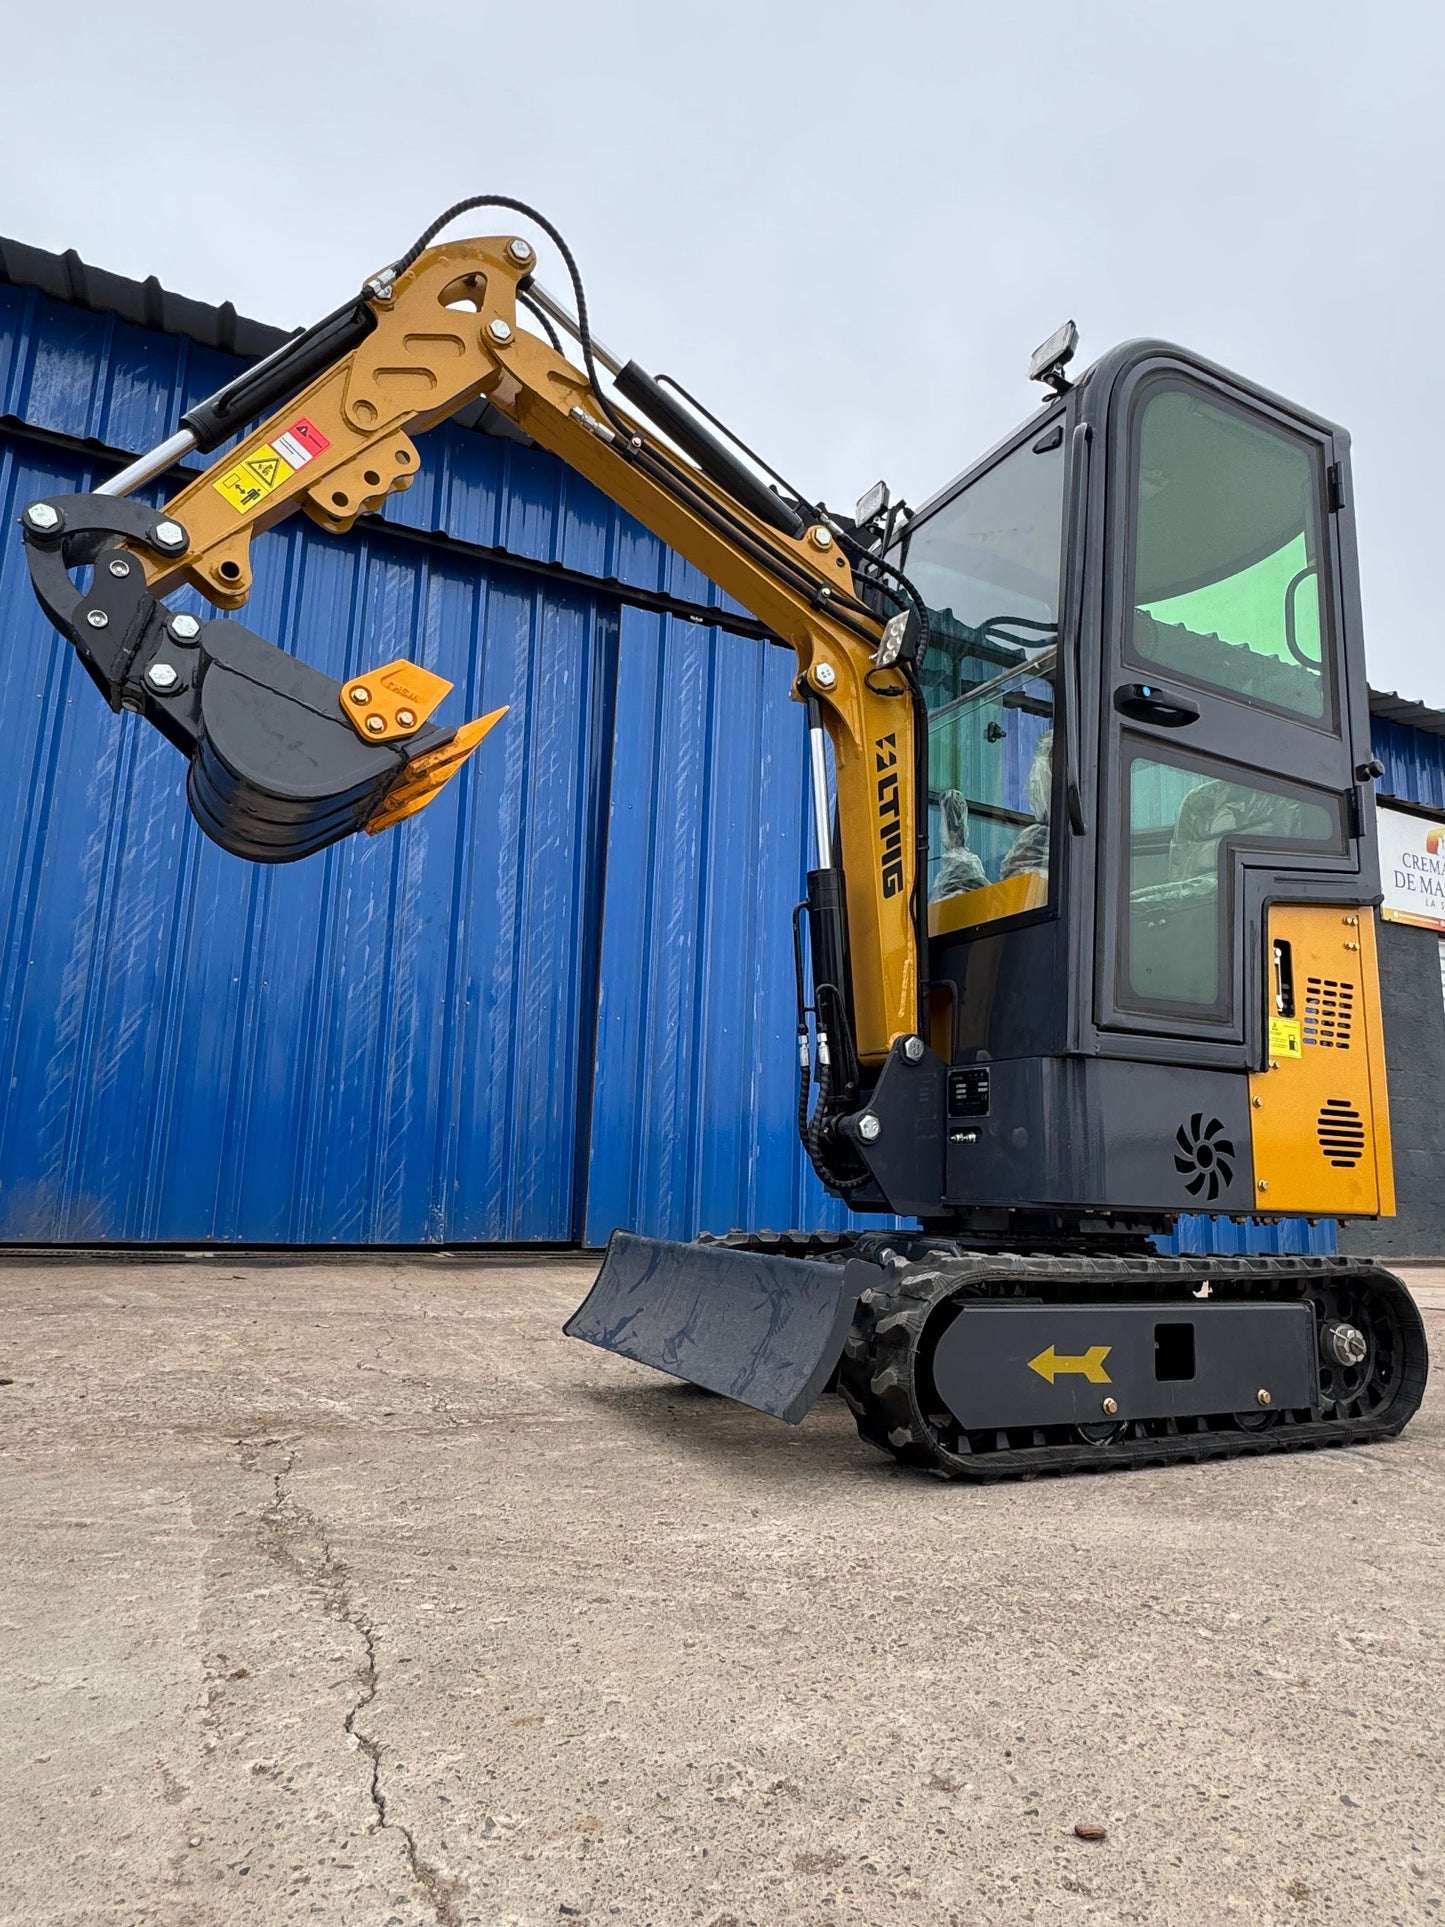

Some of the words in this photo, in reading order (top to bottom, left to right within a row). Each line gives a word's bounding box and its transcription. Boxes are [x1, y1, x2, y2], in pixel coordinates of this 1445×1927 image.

[1394, 870, 1416, 891] DE
[1420, 875, 1445, 898] MA
[1425, 898, 1435, 908] LA
